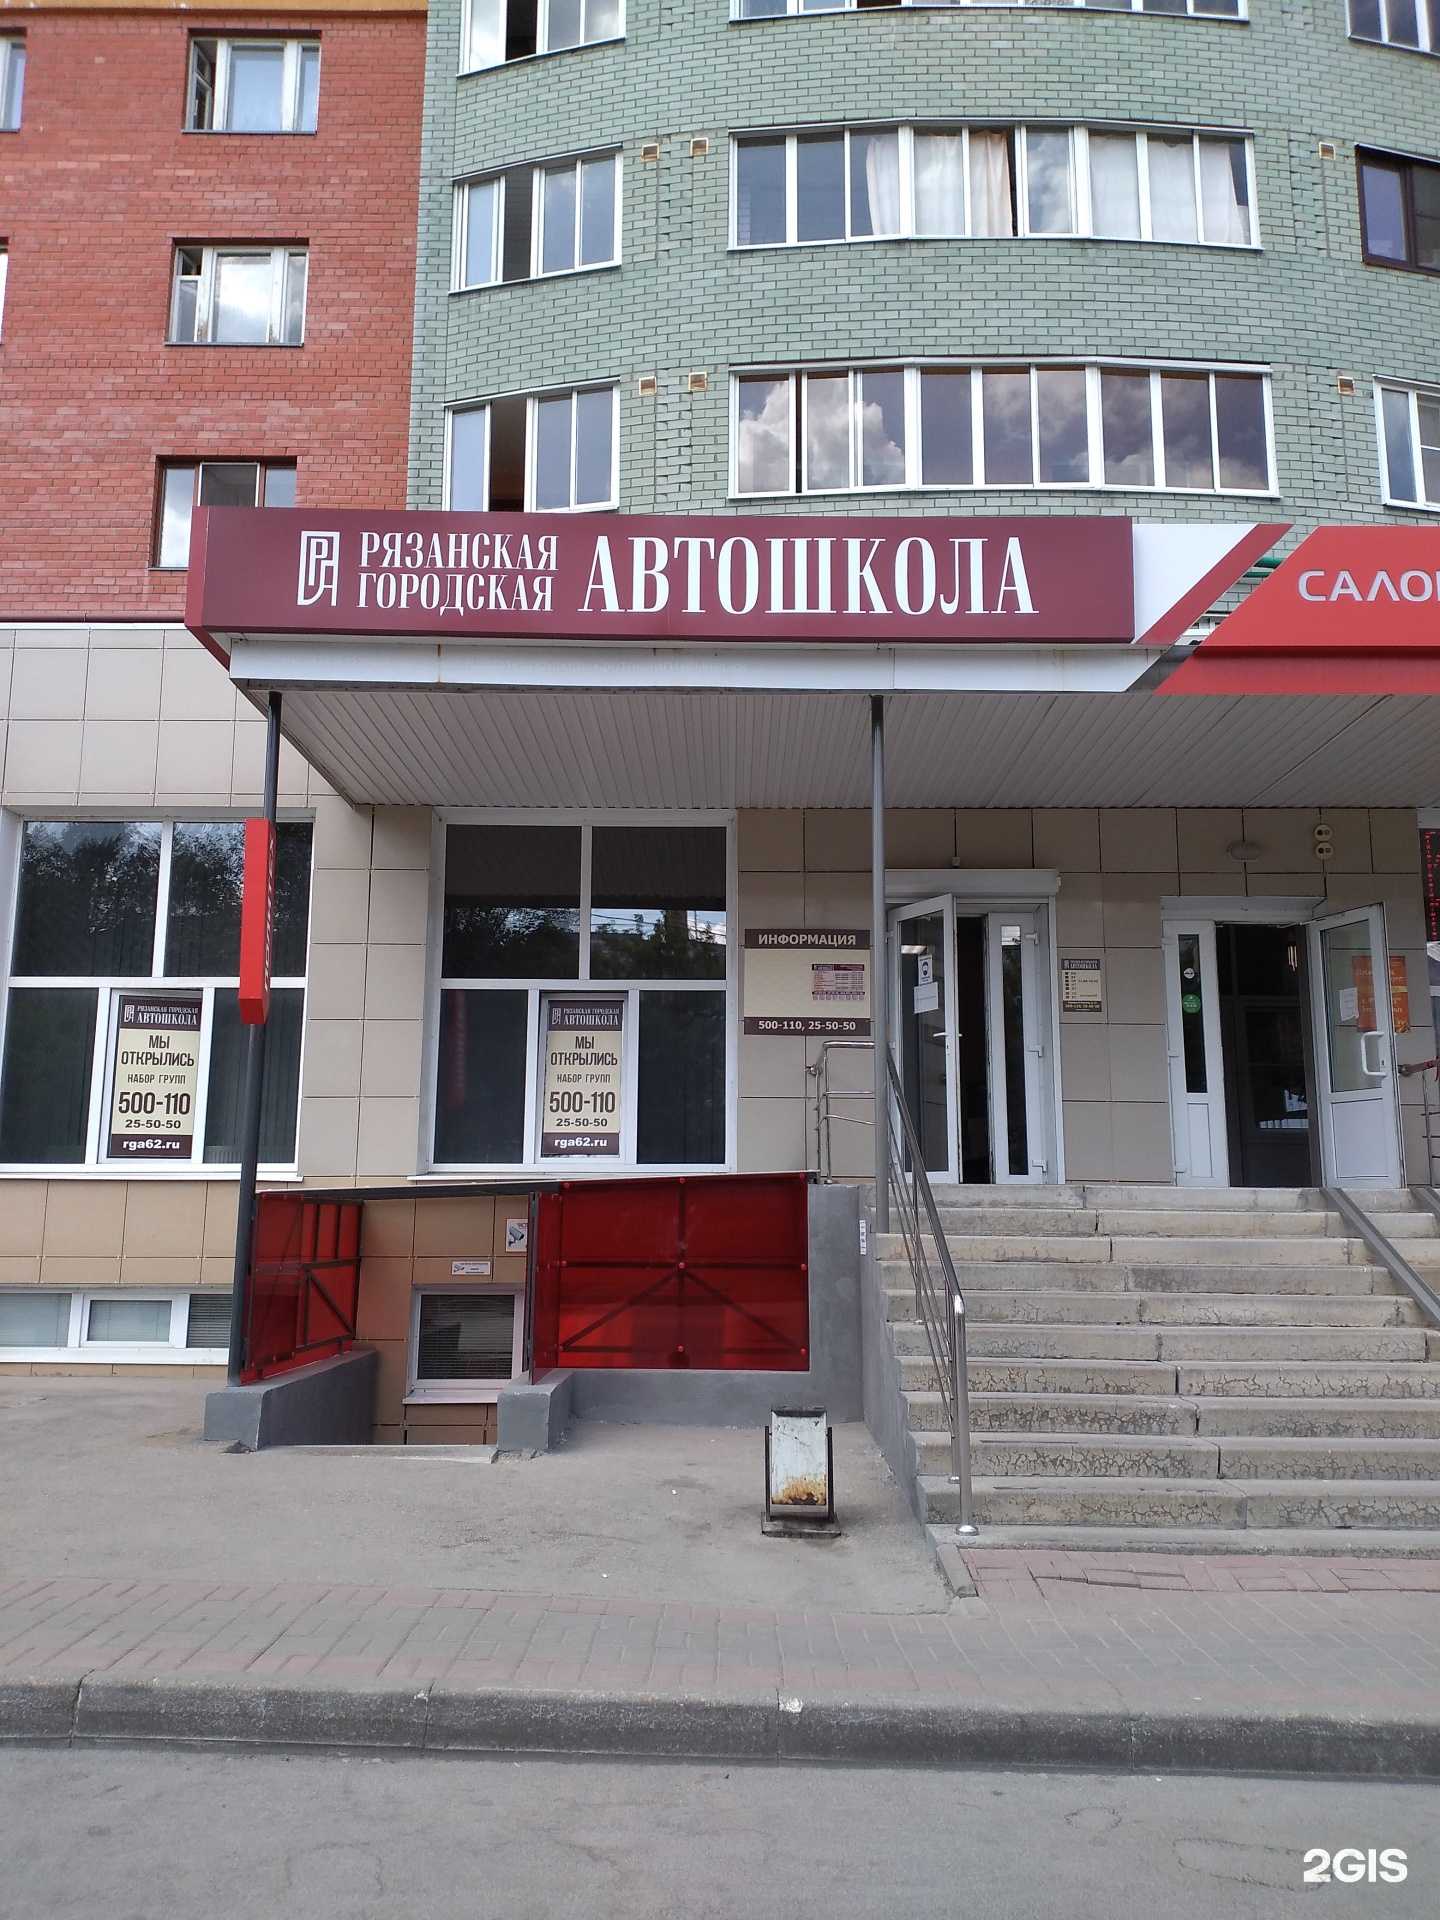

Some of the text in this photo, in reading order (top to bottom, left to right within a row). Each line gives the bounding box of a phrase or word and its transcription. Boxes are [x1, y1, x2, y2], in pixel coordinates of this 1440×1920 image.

[358, 531, 559, 571] РЯЗАНСКАЯ
[577, 535, 1039, 615] АВТОШКОЛА
[1298, 570, 1440, 602] САЛО
[356, 572, 554, 616] ГОРОДСКАЯ
[758, 934, 856, 947] ИНФОРМАЦИЯ
[136, 1012, 198, 1025] АВТОШКОЛА
[563, 1014, 619, 1025] АВТОШКОЛА
[758, 1020, 856, 1031] 500-110, 25-50-50
[148, 1034, 170, 1049] МЫ
[575, 1036, 594, 1049] МЫ
[121, 1051, 195, 1067] ОТКРЫЛИСЬ
[550, 1052, 618, 1066] ОТКРЫЛИСЬ
[127, 1073, 186, 1085] НАБОР ГРУПП
[556, 1073, 611, 1083] НАБОР ГРУПП
[118, 1091, 191, 1115] 500-110
[550, 1091, 616, 1113] 500-110
[125, 1119, 181, 1129] 25-50-50
[556, 1118, 608, 1127] 25-50-50
[122, 1139, 180, 1151] rga62.ru
[554, 1137, 608, 1149] rga62.ru
